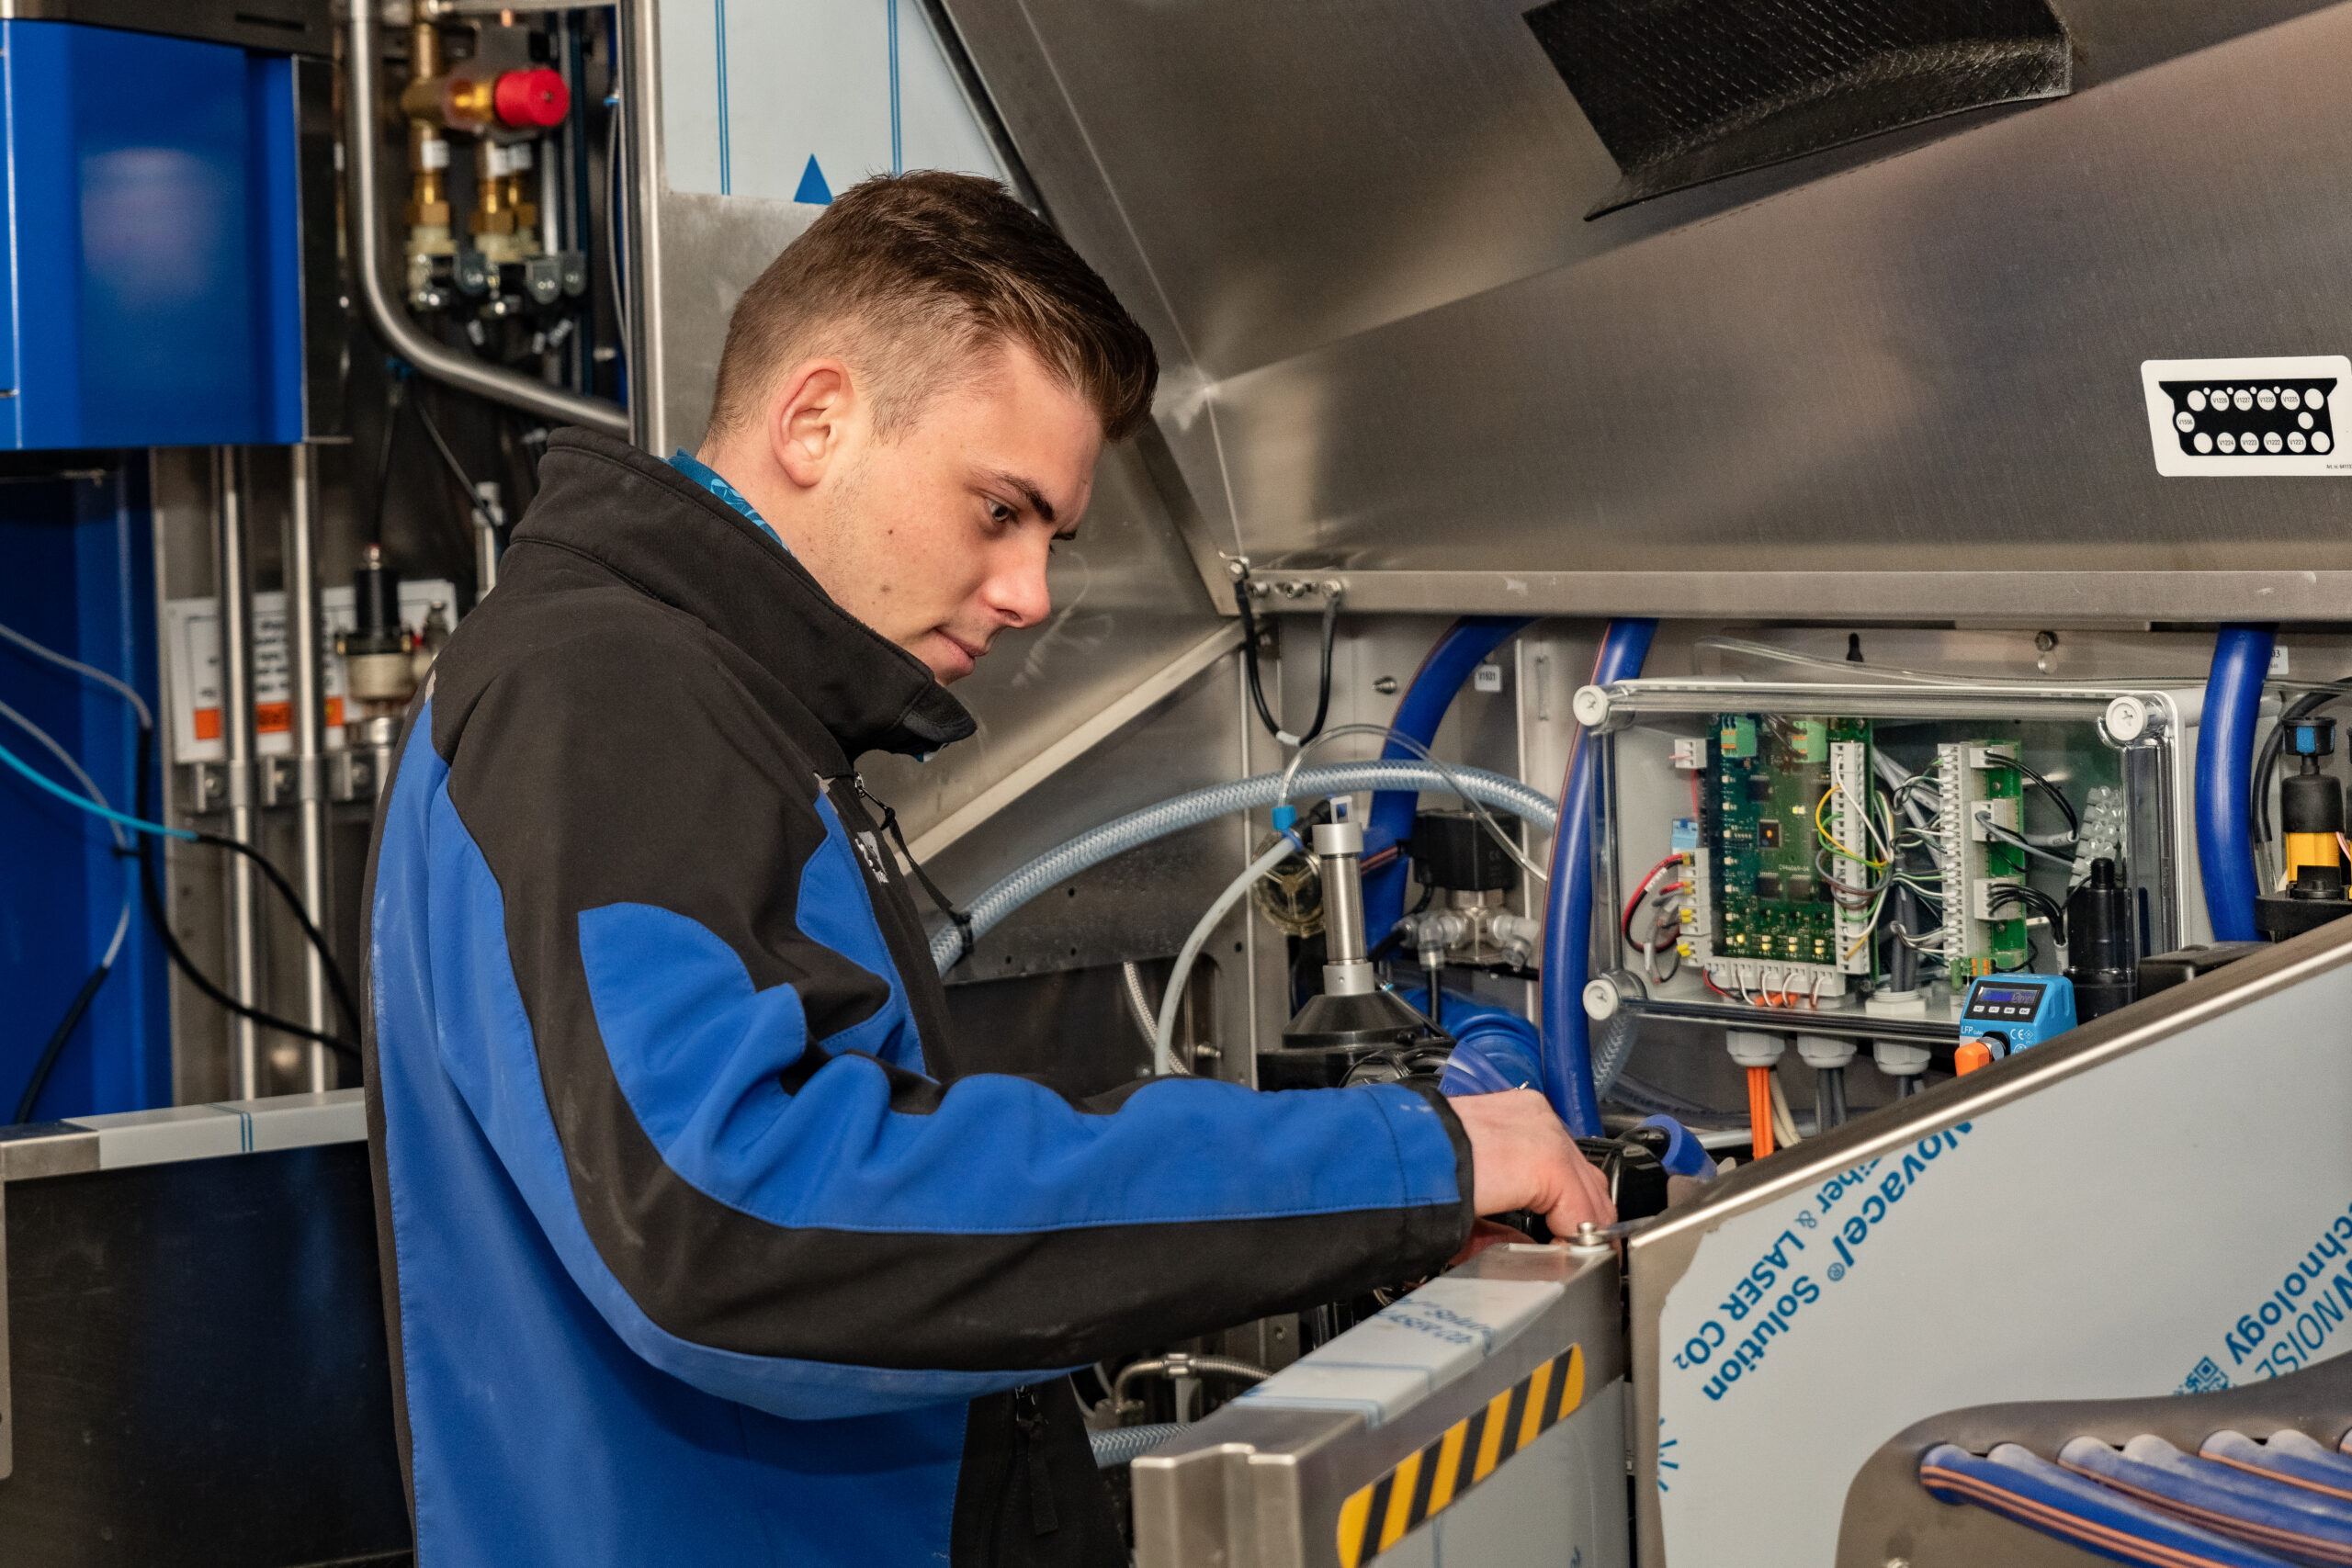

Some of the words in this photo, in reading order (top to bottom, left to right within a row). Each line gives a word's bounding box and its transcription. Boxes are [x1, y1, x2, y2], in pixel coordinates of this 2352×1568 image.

[1961, 1025, 1973, 1034] LFP
[1718, 1229, 1805, 1321] LASER
[2225, 1201, 2352, 1366] chnology
[1702, 1275, 1820, 1402] Solution
